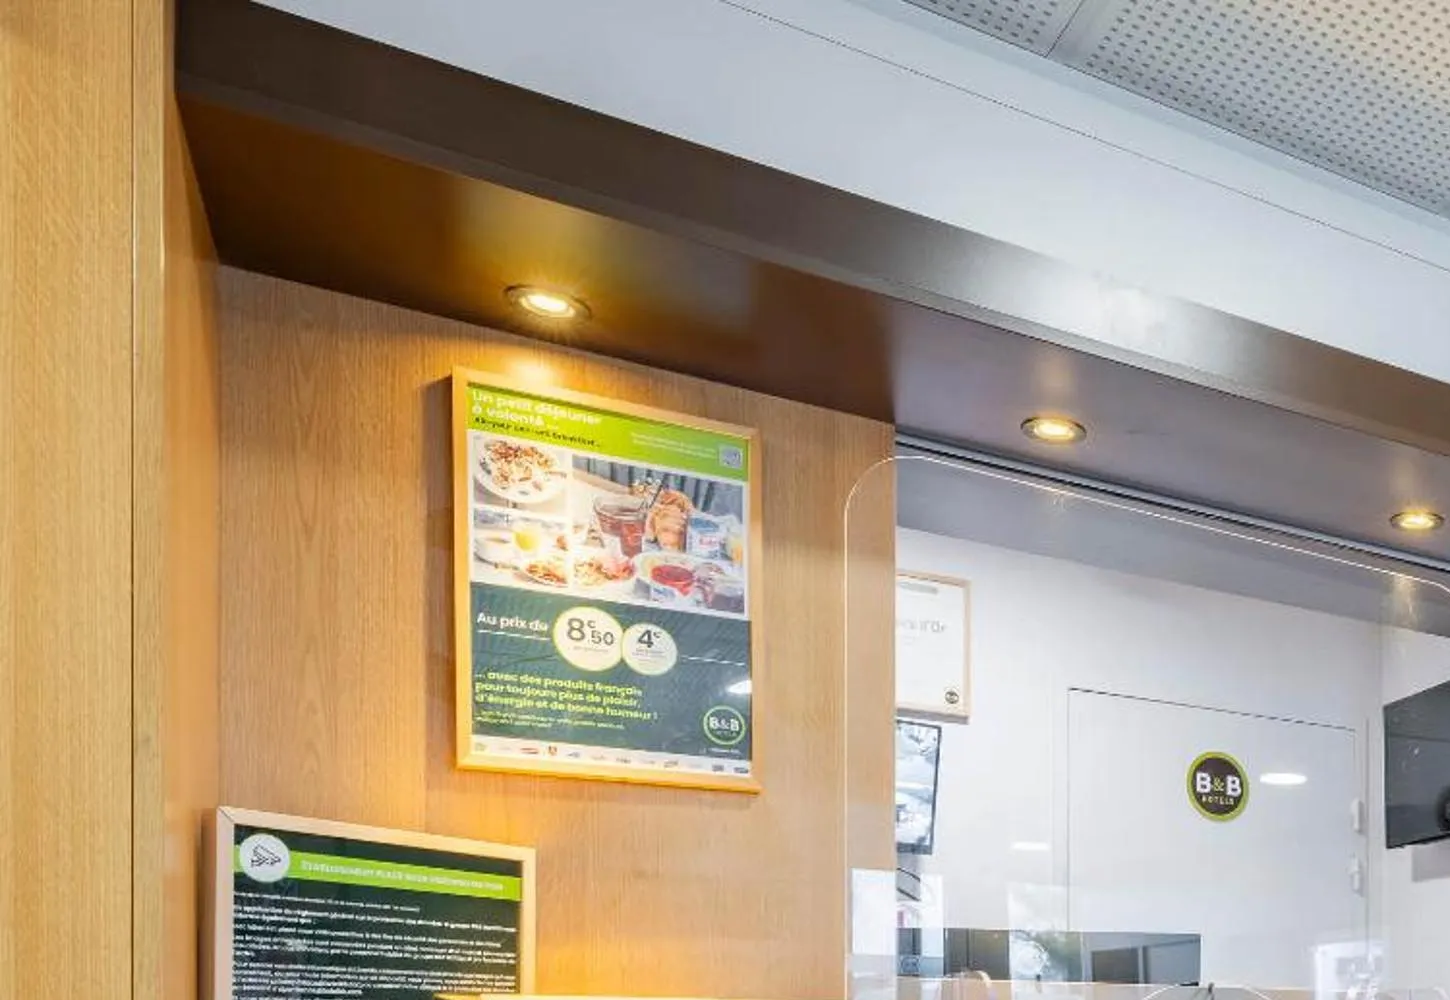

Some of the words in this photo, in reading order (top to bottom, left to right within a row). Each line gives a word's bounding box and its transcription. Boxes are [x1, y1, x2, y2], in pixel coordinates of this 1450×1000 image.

[476, 611, 497, 626] Au
[499, 616, 527, 630] prix
[529, 620, 549, 632] de
[475, 682, 505, 695] pour
[506, 684, 558, 699] toujours
[558, 689, 584, 703] plus
[586, 692, 602, 703] de
[487, 671, 518, 682] avec
[519, 674, 542, 685] des
[544, 676, 594, 692] produits
[595, 682, 643, 698] français
[536, 700, 549, 709] et
[550, 700, 565, 711] de
[567, 702, 605, 715] bonne
[606, 706, 652, 721] humeur
[1196, 772, 1242, 797] B&B
